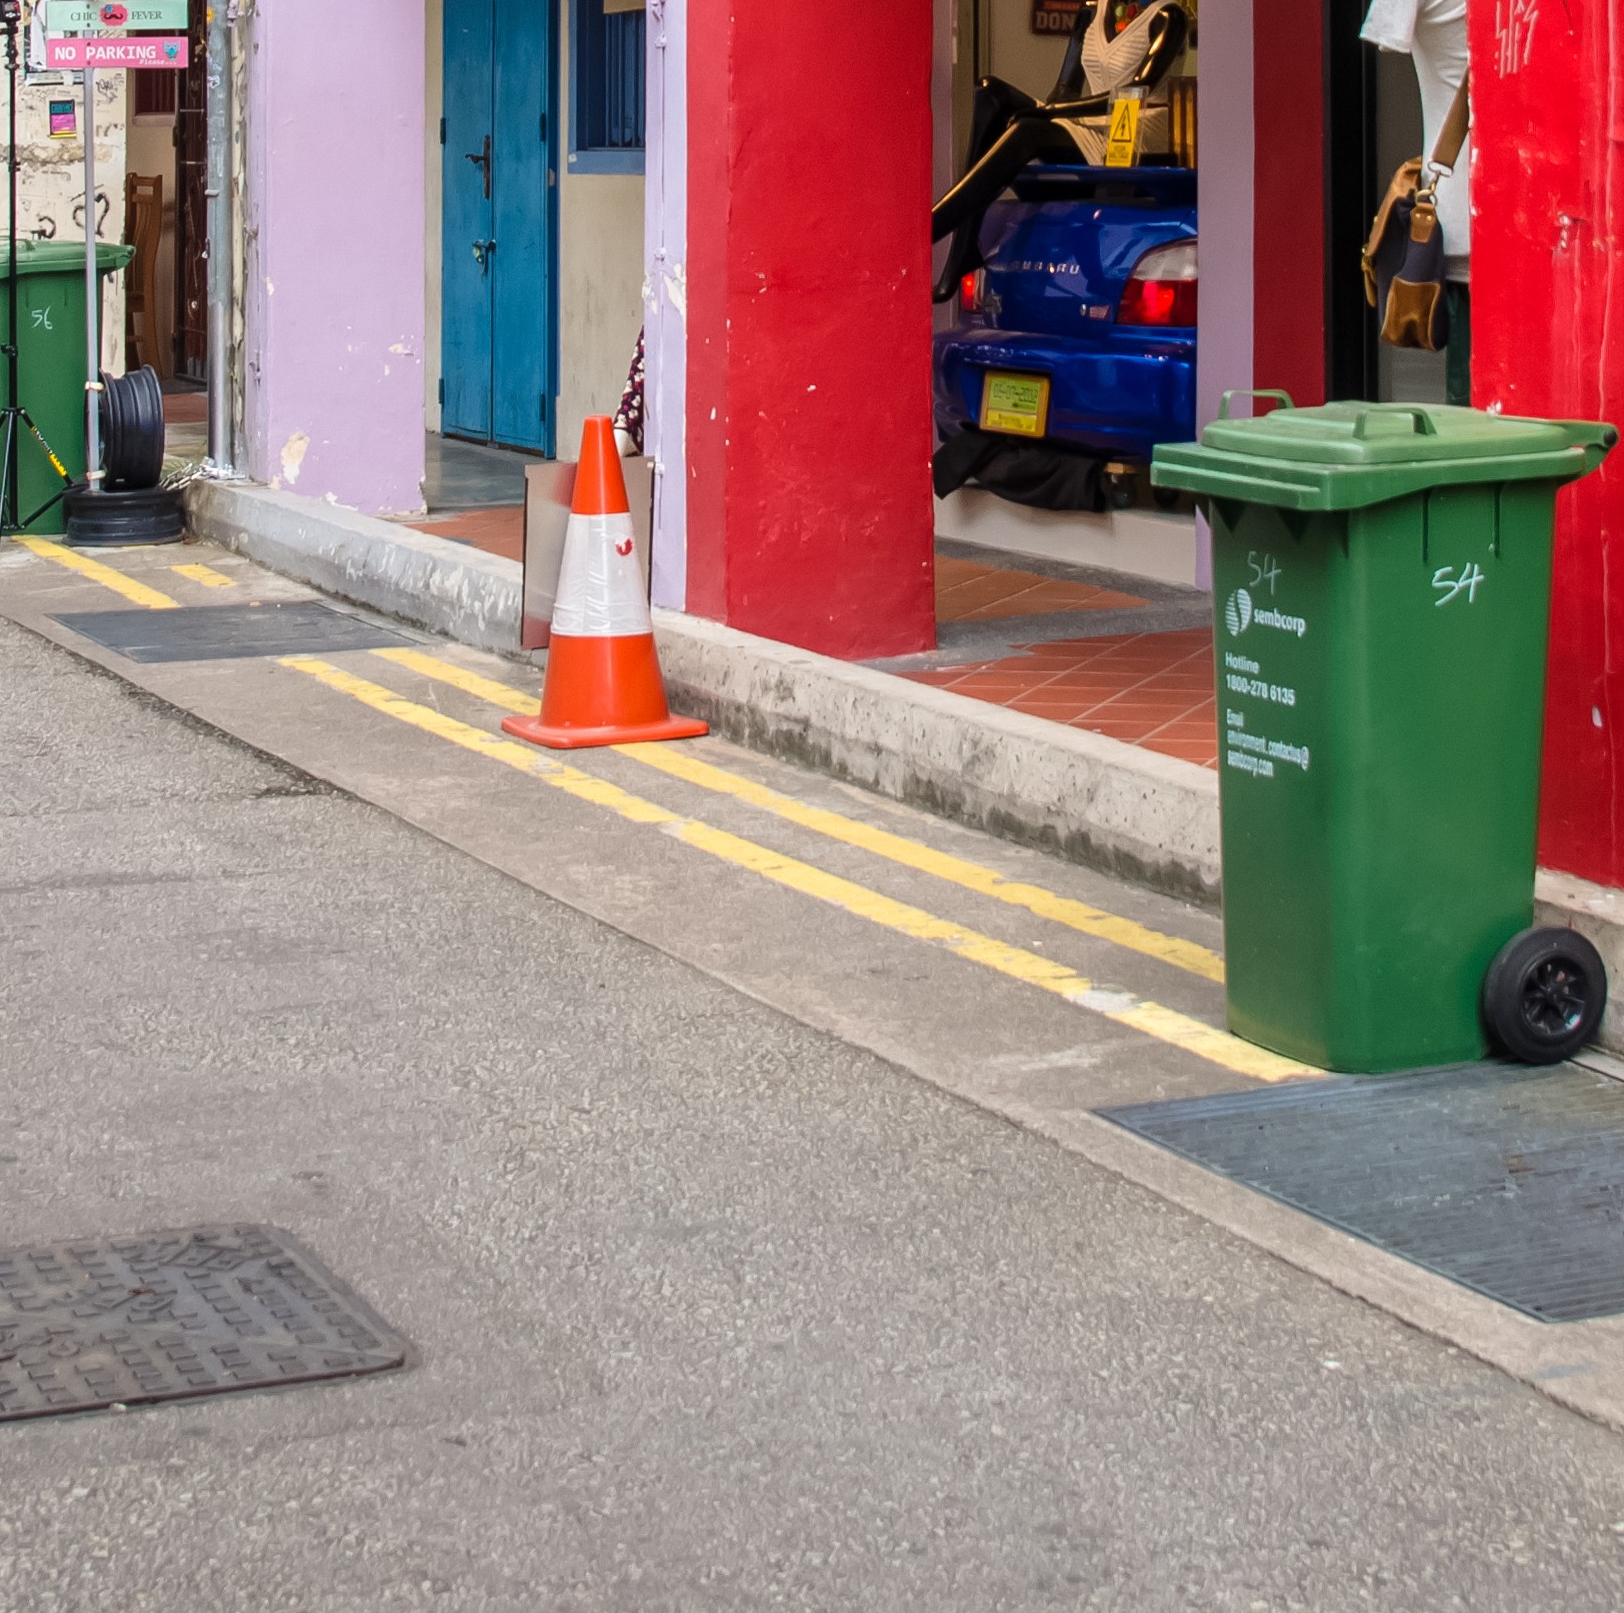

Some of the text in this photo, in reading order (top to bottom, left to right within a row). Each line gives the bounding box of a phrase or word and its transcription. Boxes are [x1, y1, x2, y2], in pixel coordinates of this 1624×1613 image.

[70, 10, 163, 22] CHIC FEVER
[54, 45, 156, 61] NO PARKING
[31, 306, 53, 330] 56
[1247, 549, 1282, 596] 54
[1431, 562, 1485, 607] 54
[1254, 606, 1307, 638] sembcorp
[1225, 651, 1260, 675] Hotline
[1225, 674, 1296, 707] 1800-278 6135
[1226, 708, 1244, 728] Email
[1227, 749, 1274, 777] sembcorp.com
